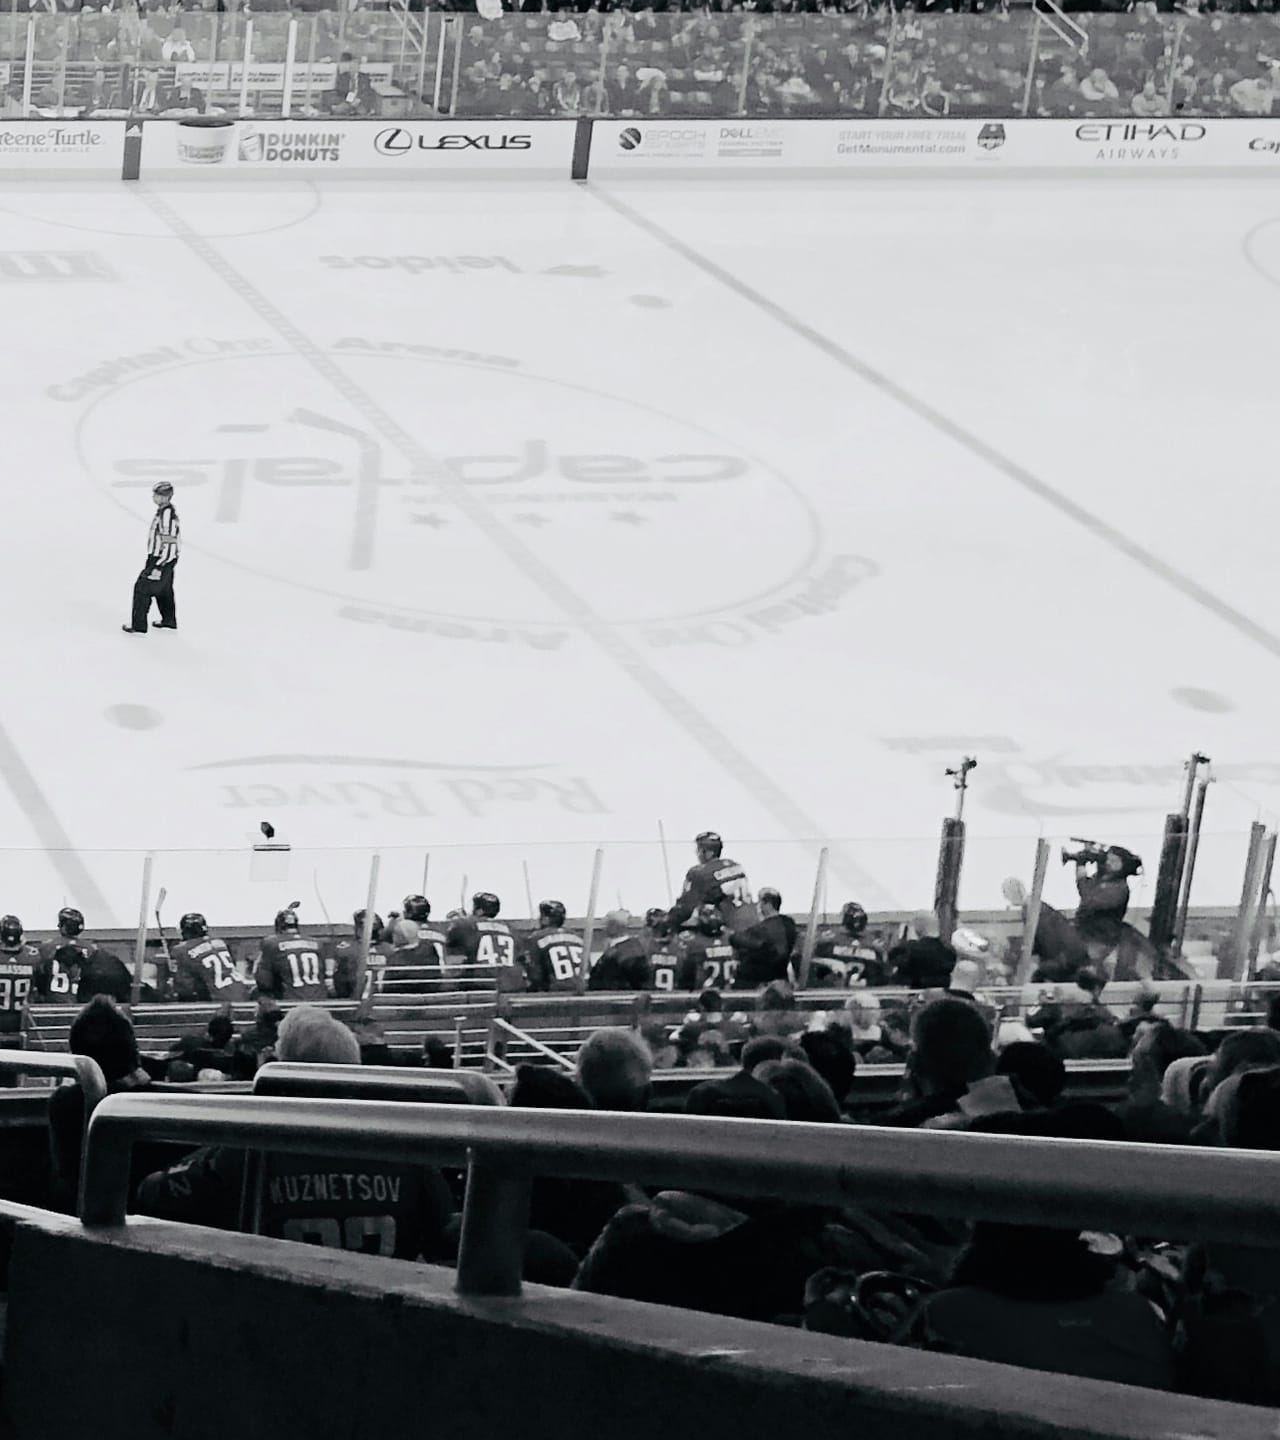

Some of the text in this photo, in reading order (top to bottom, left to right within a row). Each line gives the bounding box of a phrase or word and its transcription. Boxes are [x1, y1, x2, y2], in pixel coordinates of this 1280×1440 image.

[47, 128, 102, 147] Turtle
[267, 132, 347, 147] DUNKIN'
[417, 133, 533, 150] LEXUS
[643, 129, 707, 142] EPOCH
[719, 126, 754, 139] DELL
[1074, 123, 1207, 142] ETIHAD
[265, 146, 340, 162] DONUTS
[836, 142, 967, 157] GetMonumental.com
[1095, 146, 1180, 161] AIRWAYS
[331, 334, 522, 369] Arena
[336, 603, 571, 651] Arena
[218, 777, 614, 819] Red River
[477, 934, 515, 967] 43
[287, 952, 321, 988] 10
[269, 1172, 401, 1205] KUZNETSOV
